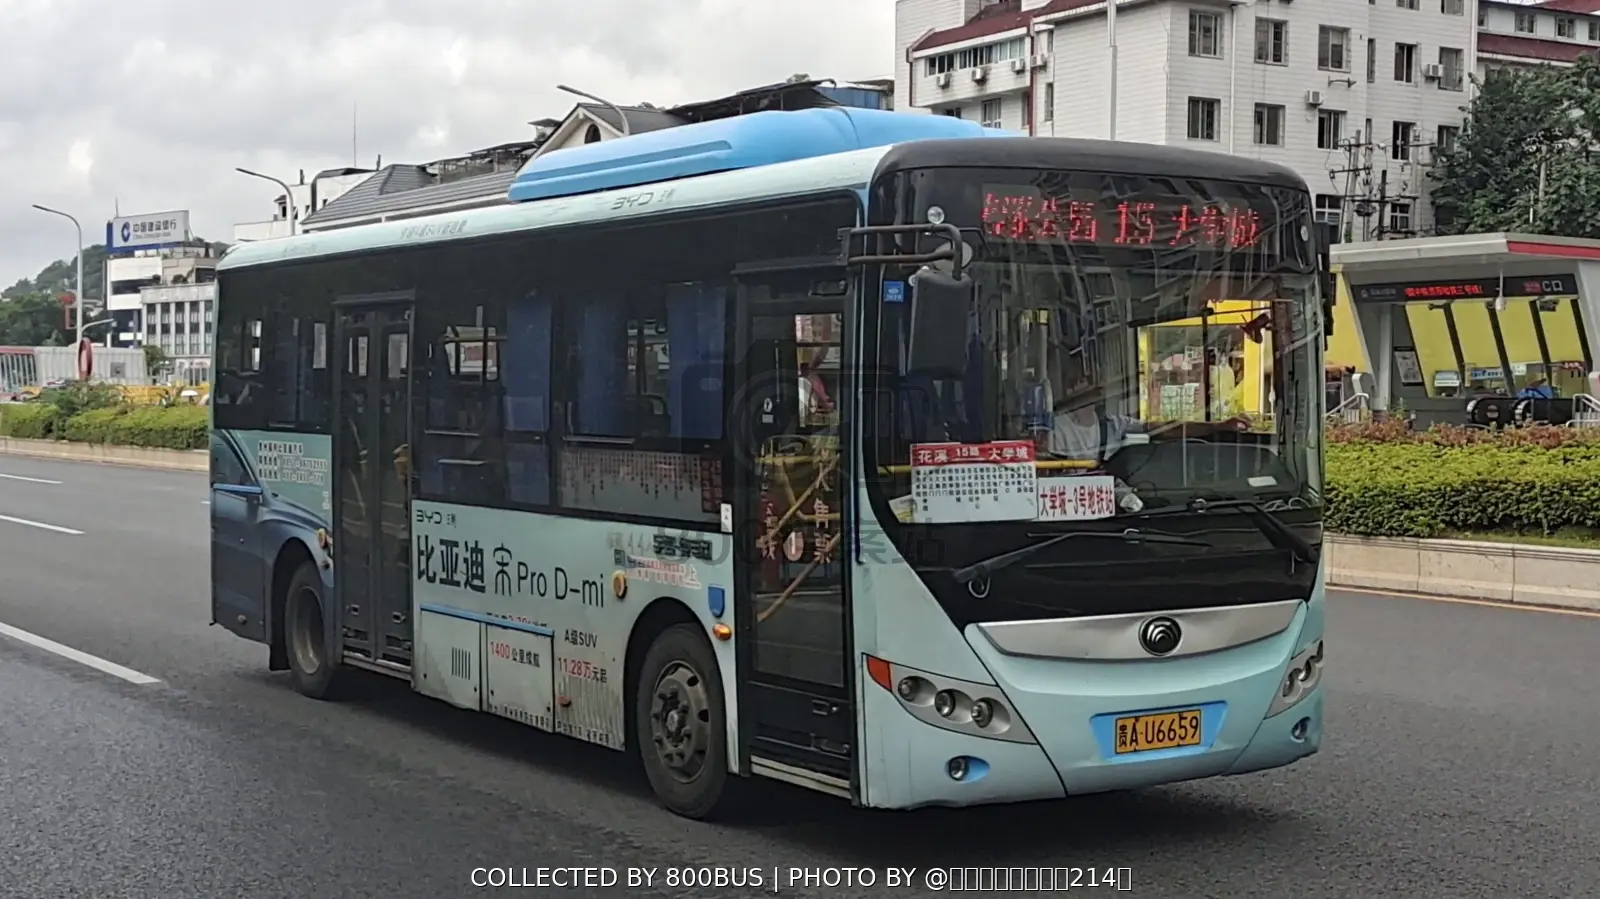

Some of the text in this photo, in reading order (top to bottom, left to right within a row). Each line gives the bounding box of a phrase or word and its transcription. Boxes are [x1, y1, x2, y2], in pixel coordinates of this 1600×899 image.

[1115, 201, 1154, 244] 15
[987, 445, 1029, 460] 大学城
[416, 534, 486, 594] 比亚迪
[517, 561, 548, 597] Pro
[554, 567, 604, 608] D-mi
